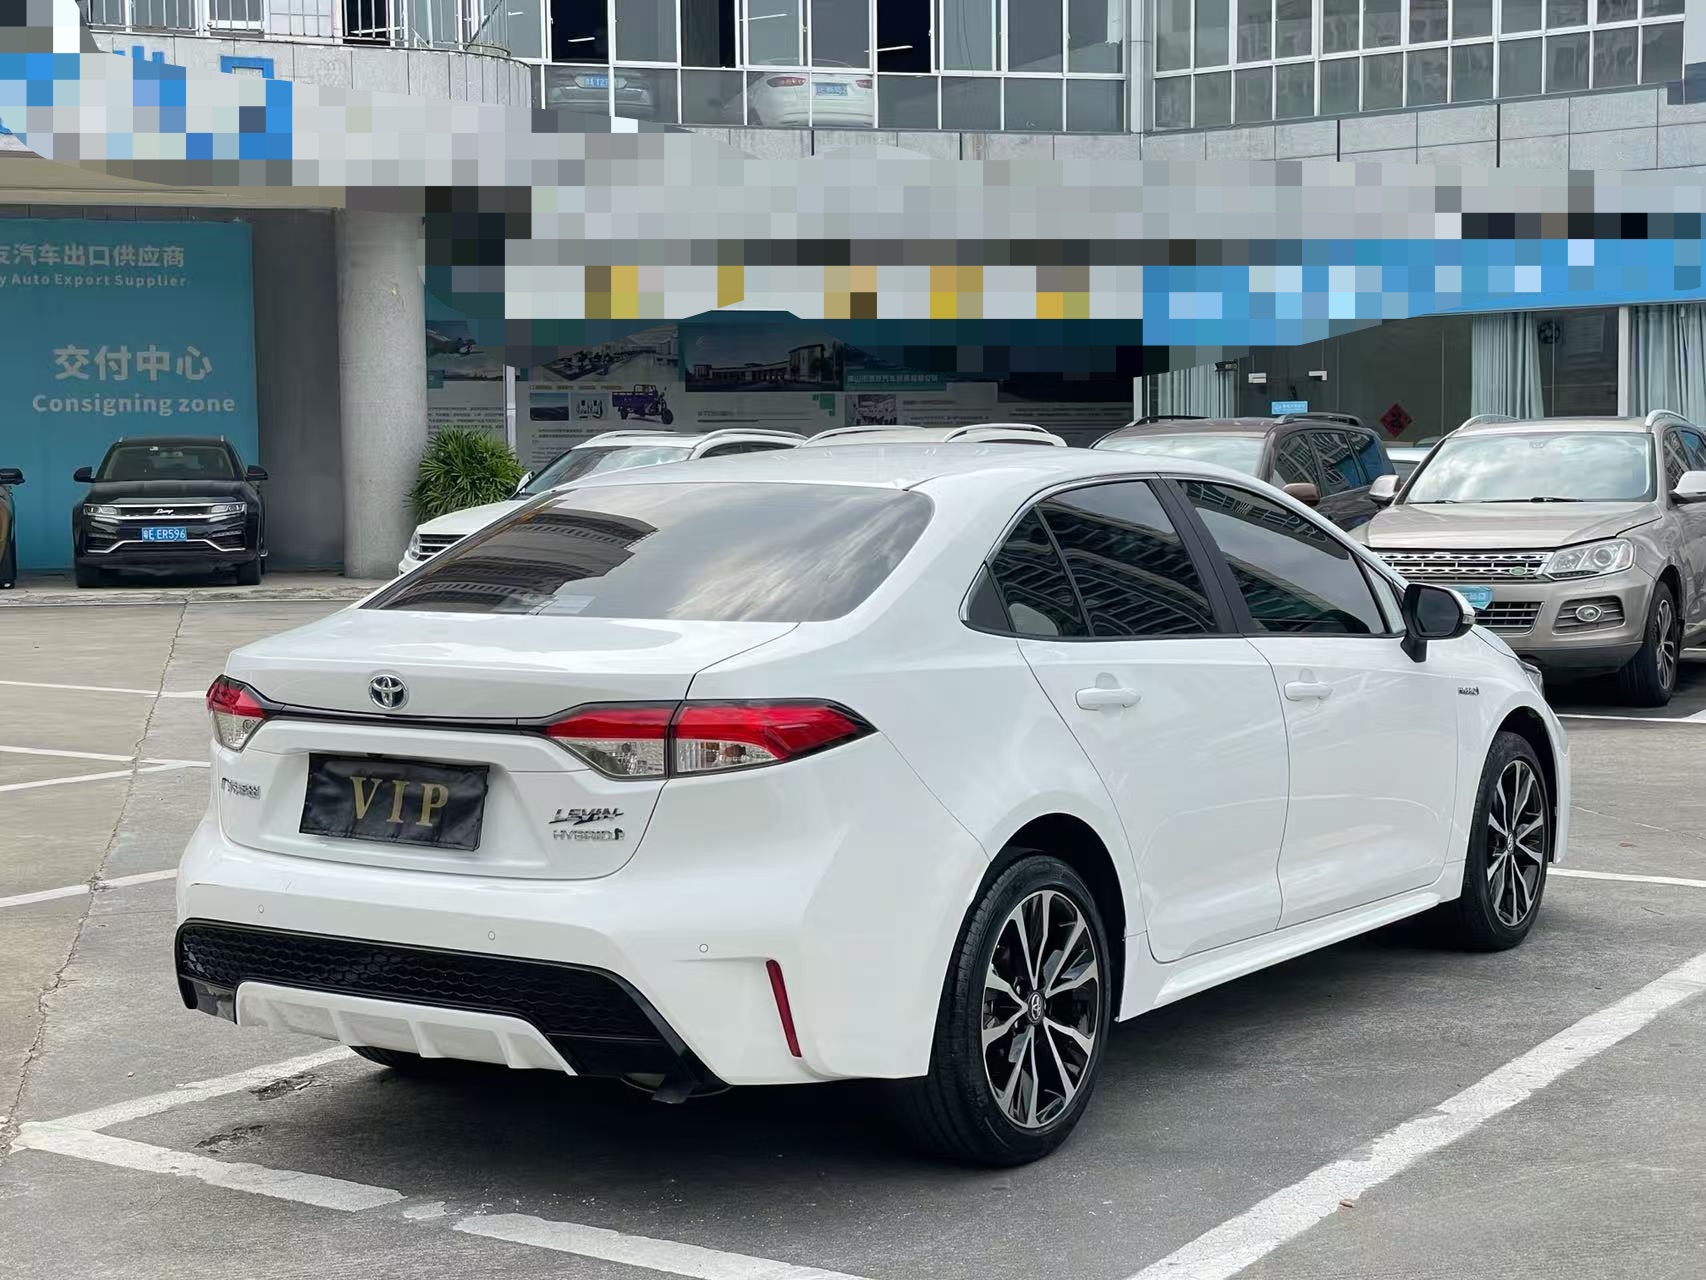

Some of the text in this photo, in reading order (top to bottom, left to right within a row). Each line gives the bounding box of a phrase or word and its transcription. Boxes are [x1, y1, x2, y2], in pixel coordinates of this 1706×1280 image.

[11, 273, 50, 285] Auto
[55, 274, 110, 287] Export
[115, 275, 187, 288] Supplier
[52, 344, 213, 381] 交付中心
[32, 393, 236, 416] Consigning zone
[349, 776, 449, 827] VIP
[552, 808, 624, 825] LEVIN
